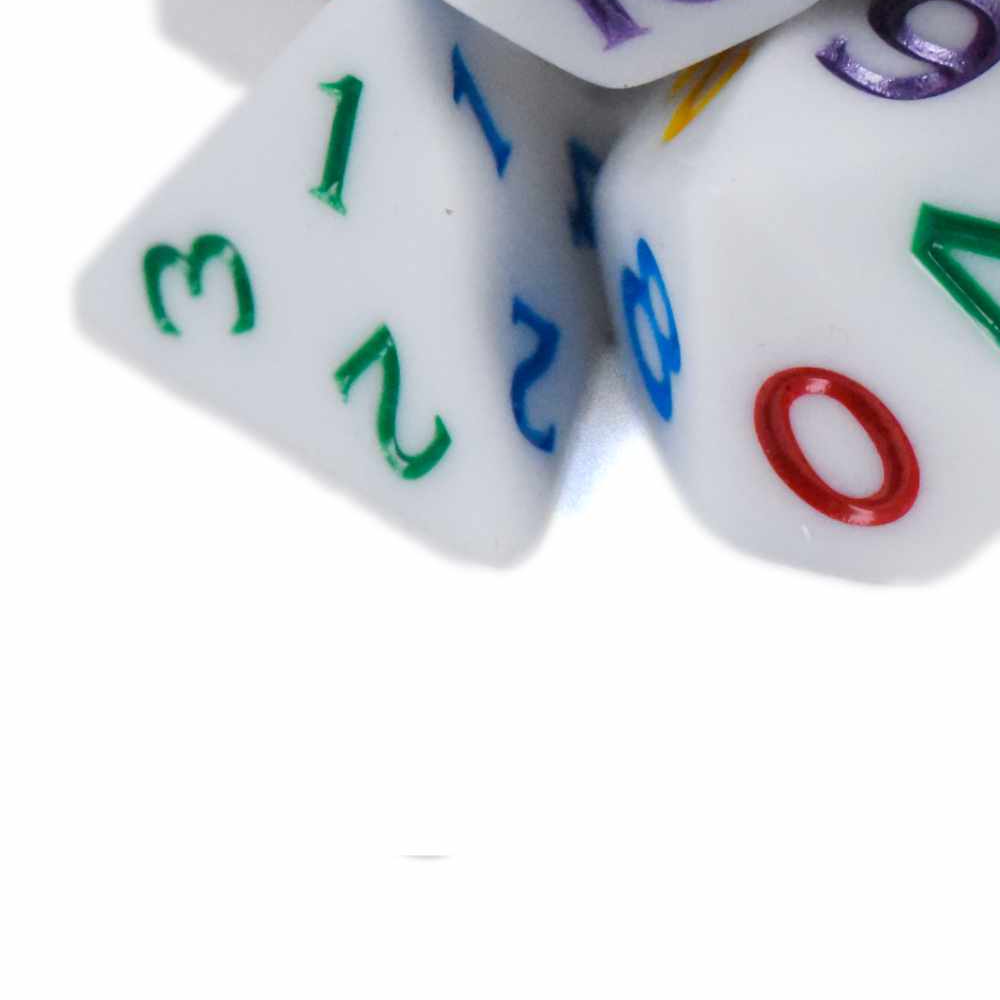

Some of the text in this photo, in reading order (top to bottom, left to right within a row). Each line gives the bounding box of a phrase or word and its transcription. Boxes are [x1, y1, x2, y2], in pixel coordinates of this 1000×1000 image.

[309, 73, 364, 215] 1
[450, 41, 512, 180] 1
[142, 232, 256, 337] 3
[620, 237, 682, 424] 8
[333, 322, 453, 481] 2
[510, 294, 562, 456] 2
[752, 365, 921, 527] 0
